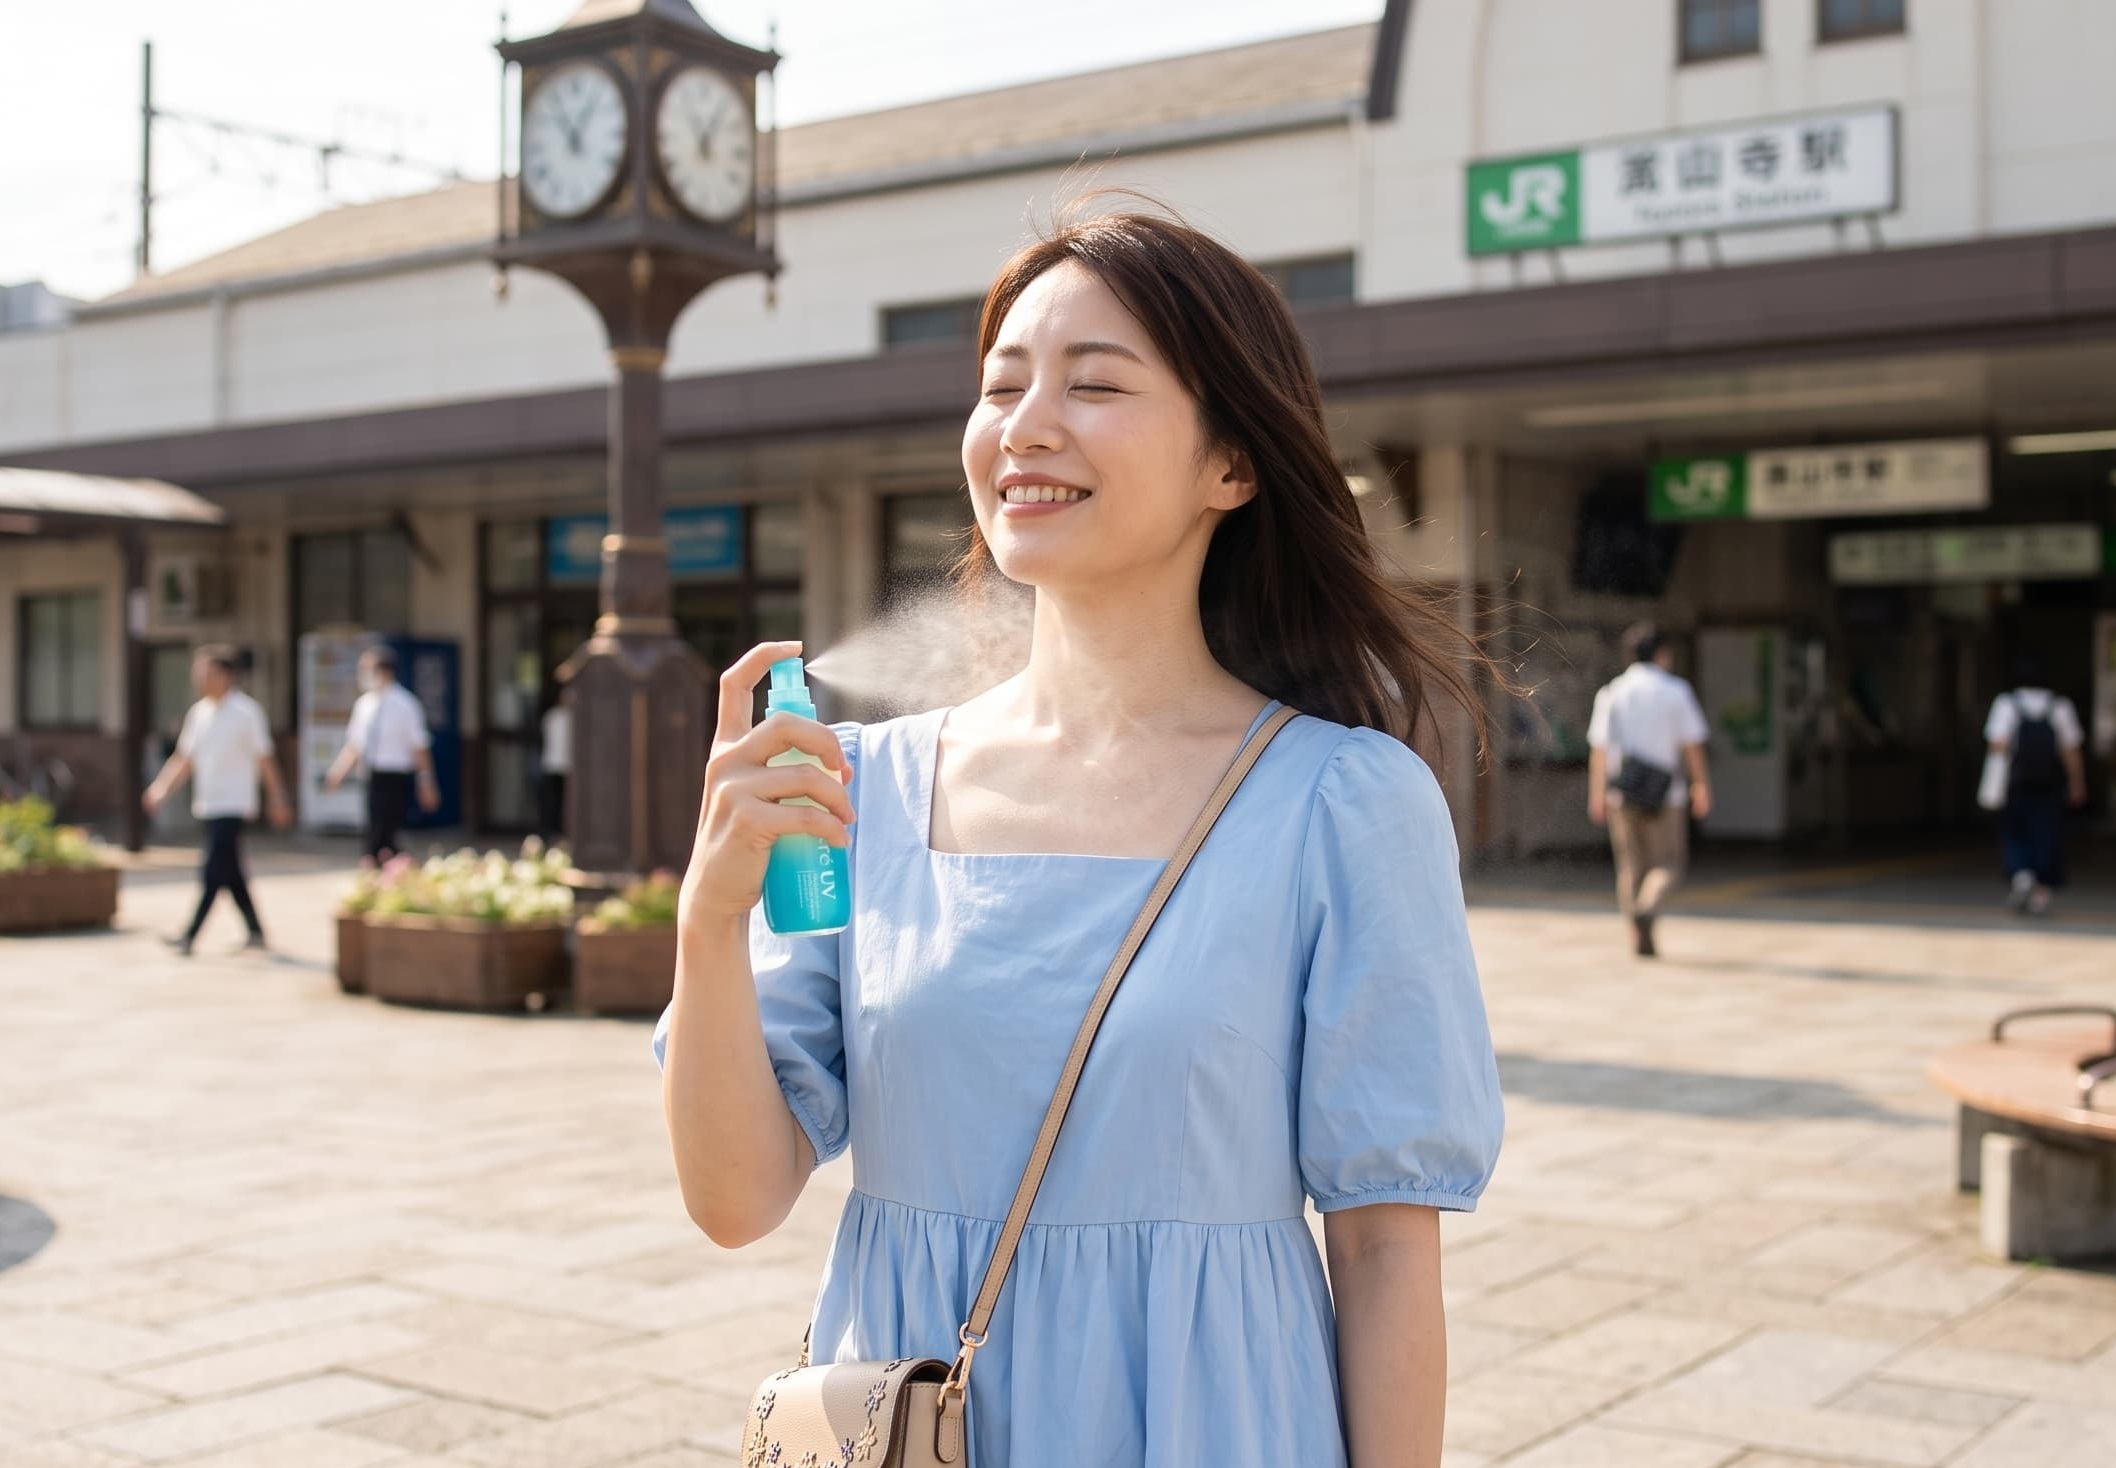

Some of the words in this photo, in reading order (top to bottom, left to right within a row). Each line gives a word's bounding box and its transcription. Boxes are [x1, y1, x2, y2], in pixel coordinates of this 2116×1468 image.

[1479, 163, 1567, 222] JR
[1664, 461, 1732, 506] JR
[820, 870, 836, 900] UV
